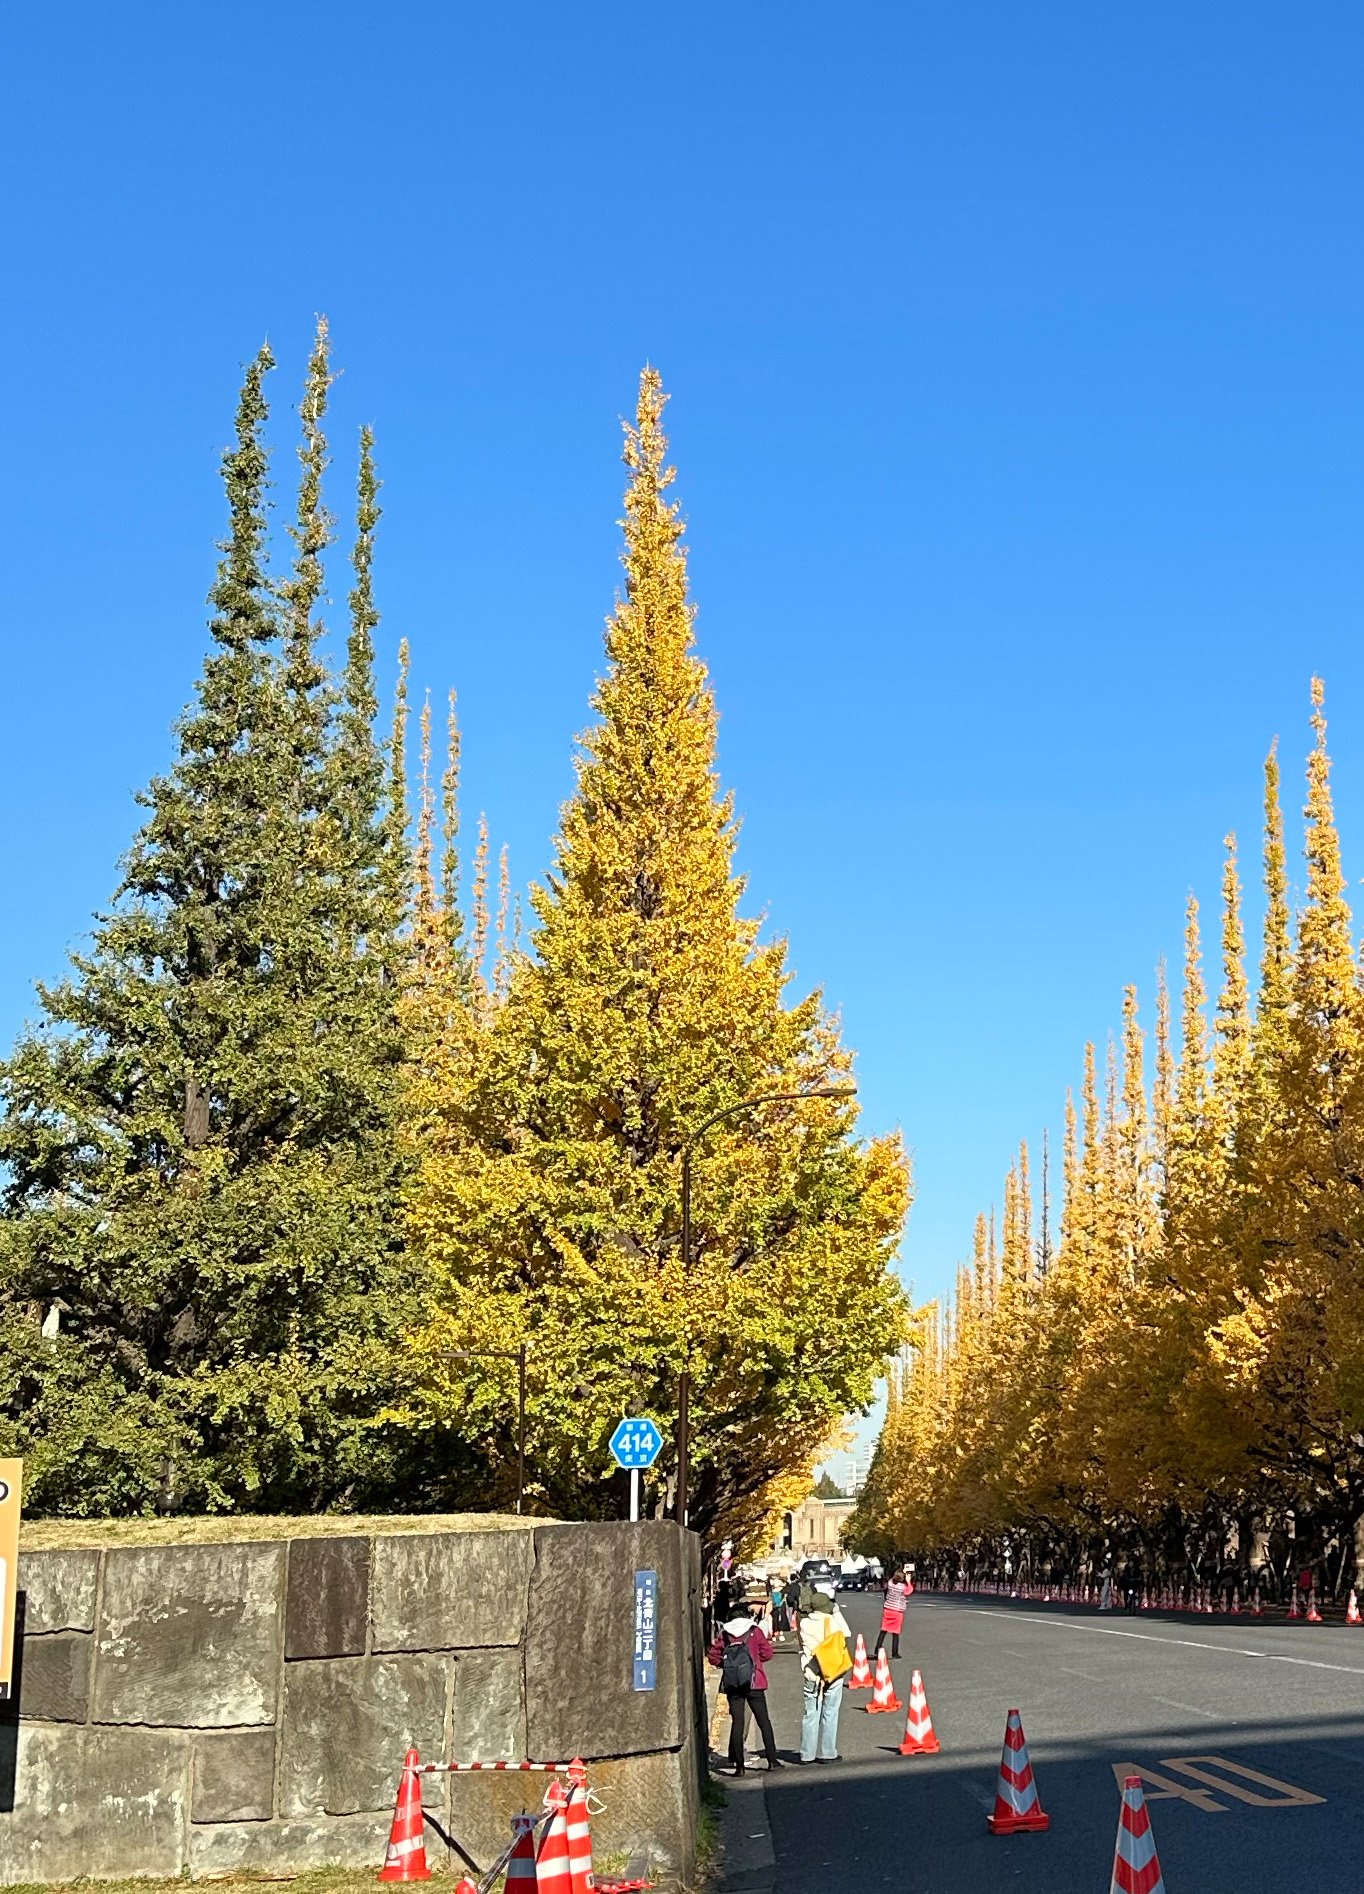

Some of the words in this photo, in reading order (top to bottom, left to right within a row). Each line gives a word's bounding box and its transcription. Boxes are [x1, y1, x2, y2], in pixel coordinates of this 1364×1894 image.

[618, 1433, 654, 1452] 414
[640, 1669, 646, 1684] 1
[1112, 1756, 1328, 1812] 40
